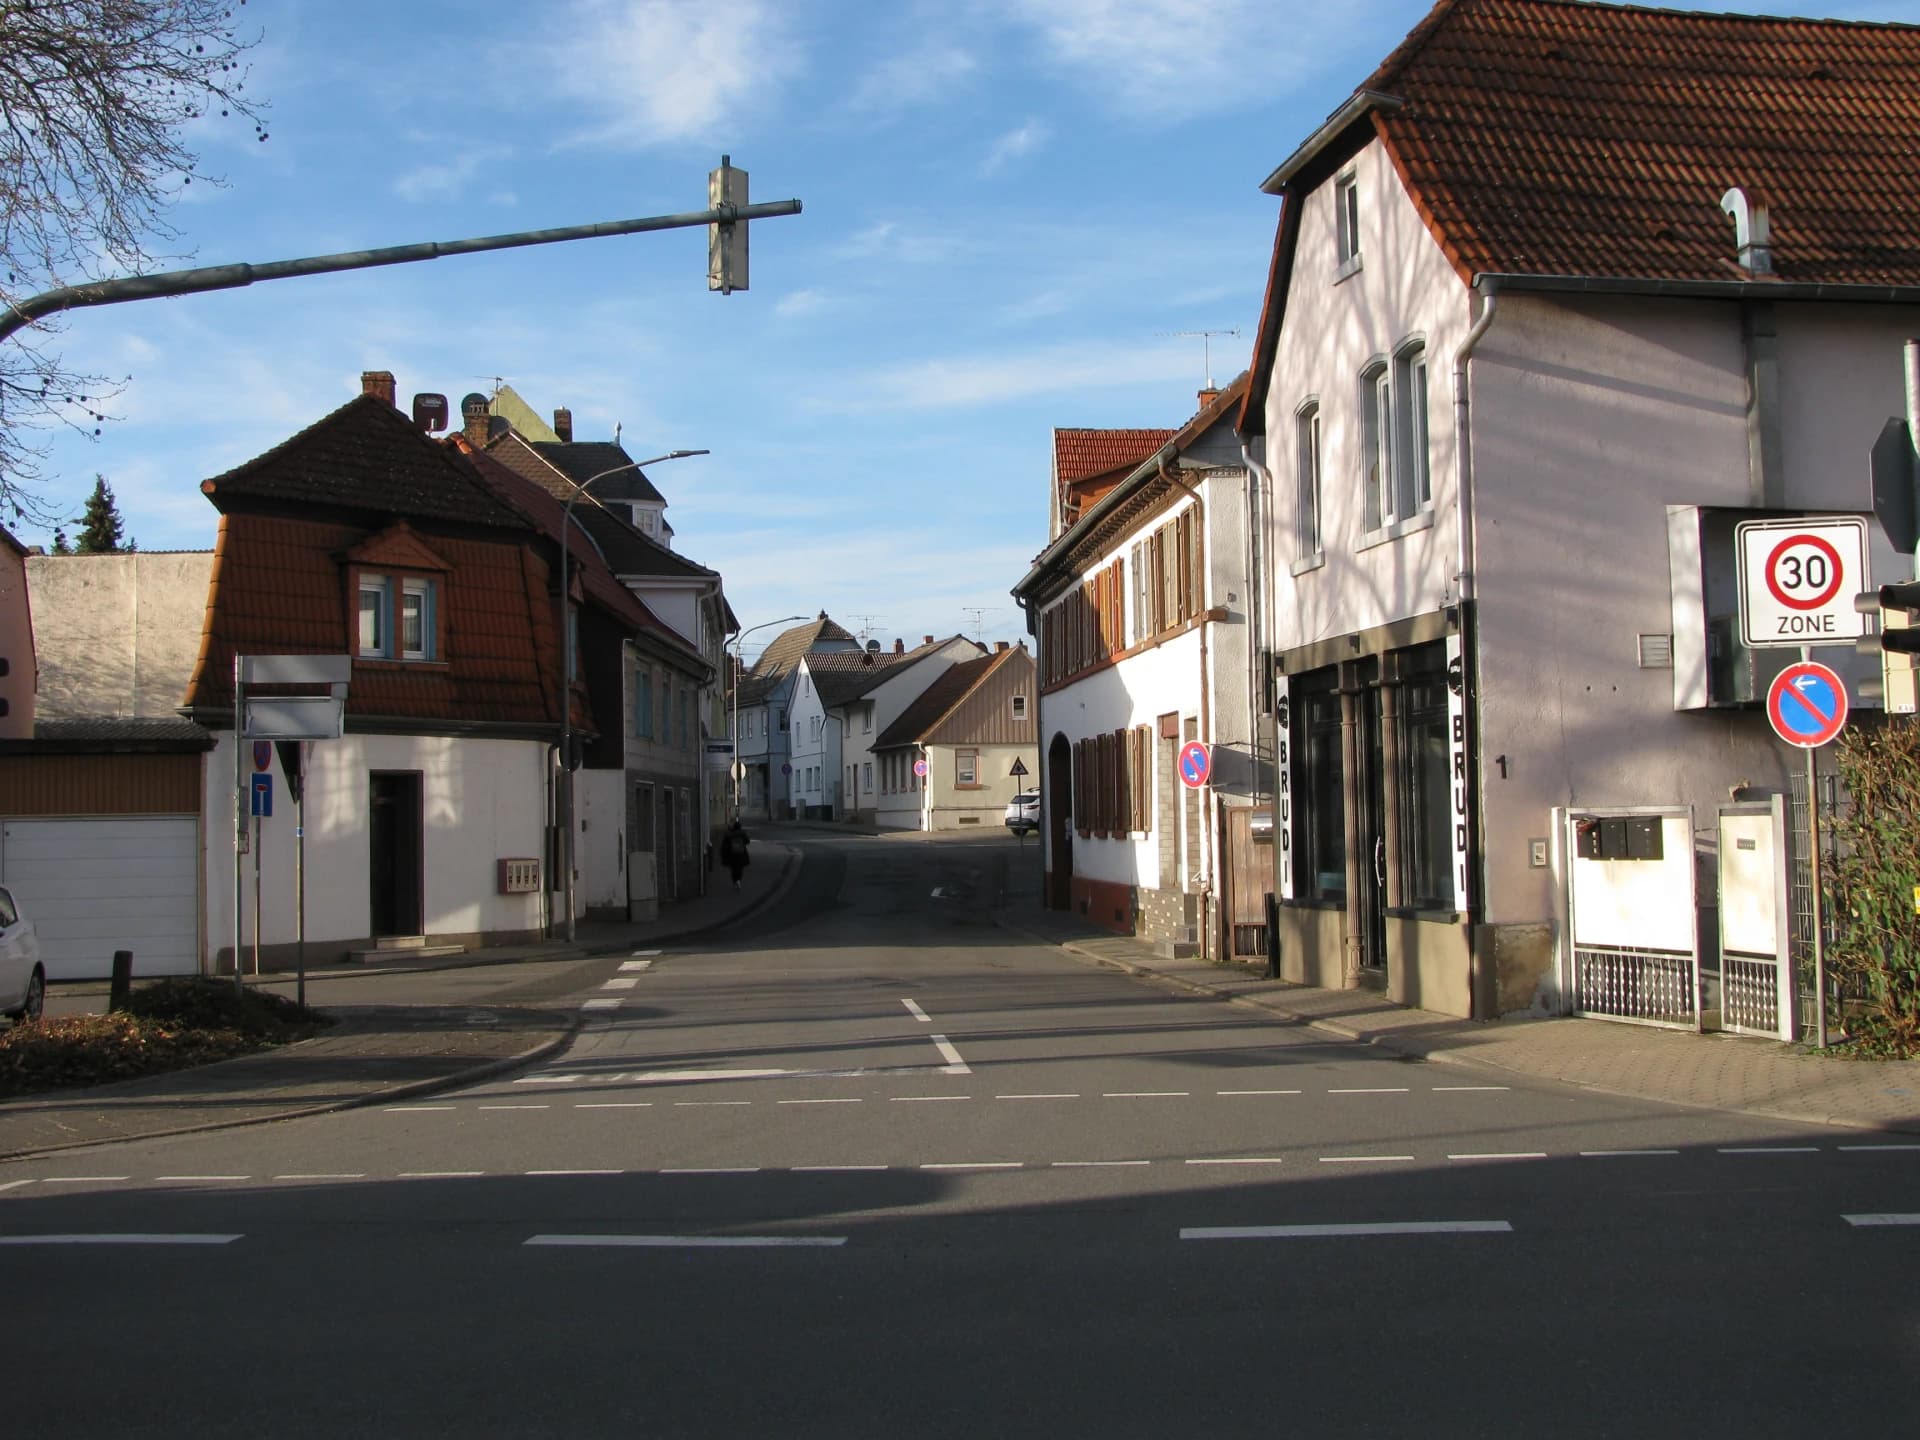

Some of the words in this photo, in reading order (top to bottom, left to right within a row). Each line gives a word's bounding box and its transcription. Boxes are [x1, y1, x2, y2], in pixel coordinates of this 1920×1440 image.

[1781, 555, 1826, 589] 30
[1777, 614, 1835, 634] ZONE
[1495, 754, 1507, 780] 1
[1280, 741, 1290, 884] BRUDI
[1453, 715, 1467, 892] BRUDI
